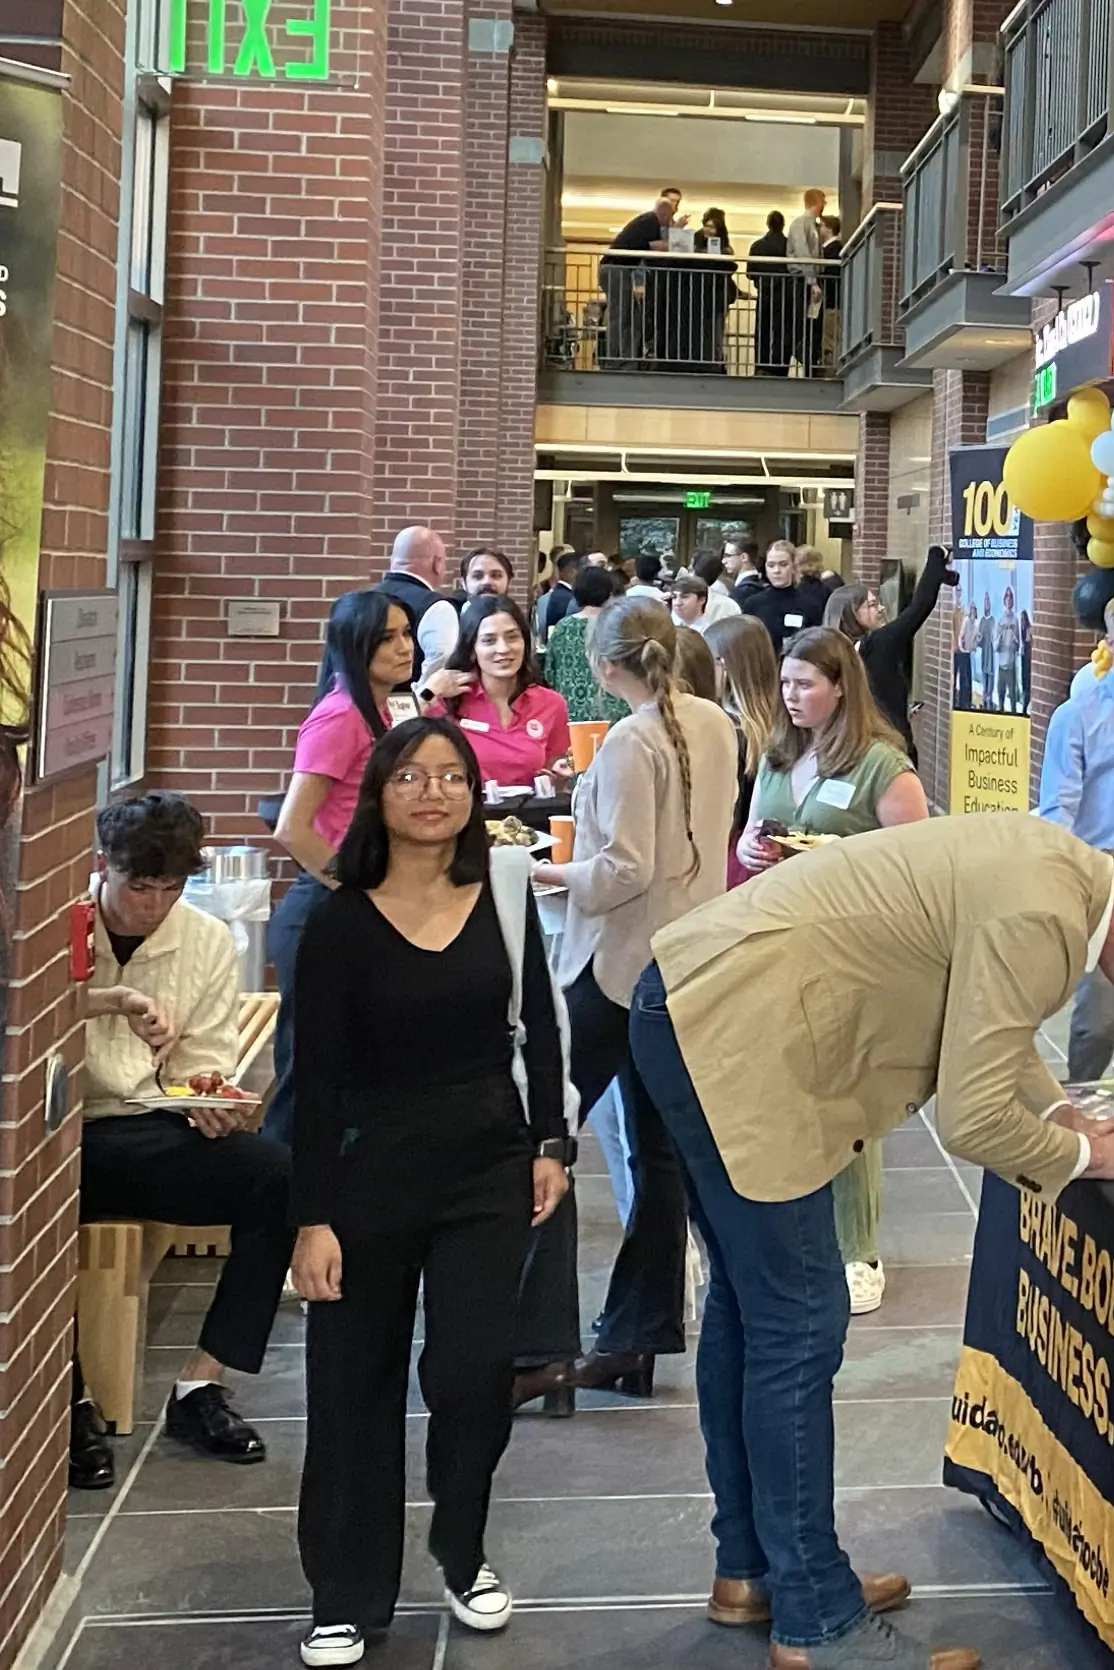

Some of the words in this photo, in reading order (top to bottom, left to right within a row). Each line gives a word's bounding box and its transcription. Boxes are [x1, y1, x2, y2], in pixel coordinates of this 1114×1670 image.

[963, 480, 1012, 537] 100
[968, 723, 975, 736] A
[975, 723, 1004, 742] Century
[1005, 727, 1015, 740] of
[964, 743, 1019, 768] Impactful
[968, 769, 1018, 795] Business
